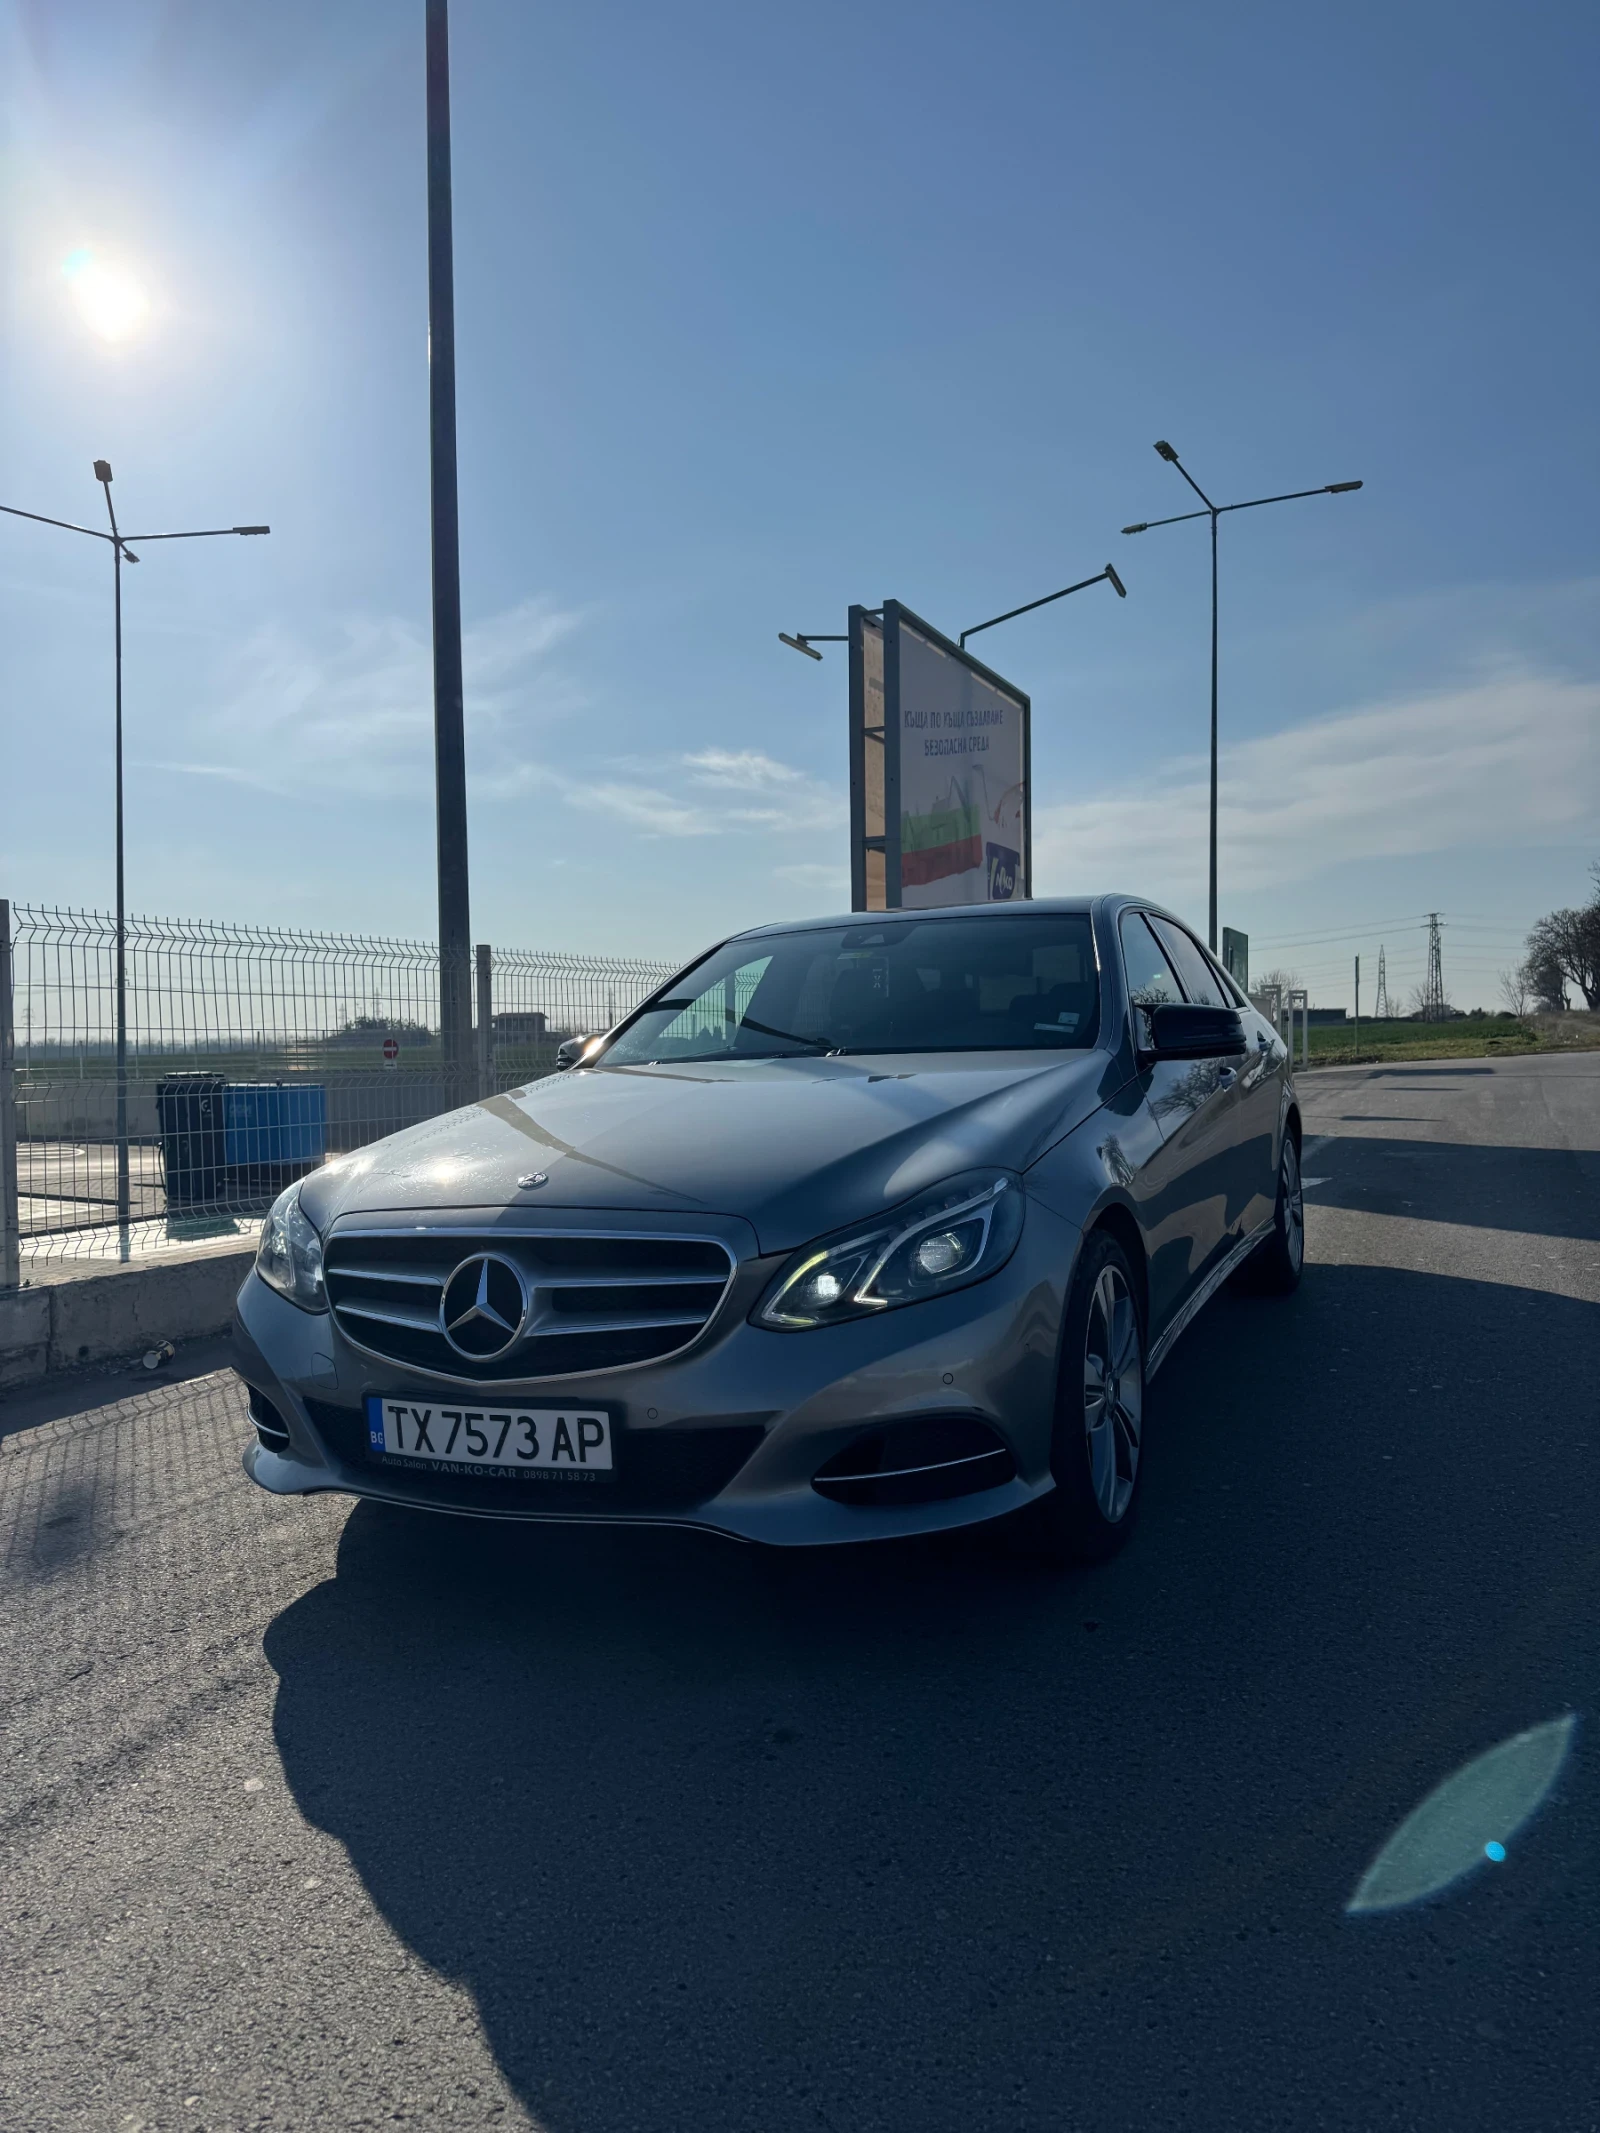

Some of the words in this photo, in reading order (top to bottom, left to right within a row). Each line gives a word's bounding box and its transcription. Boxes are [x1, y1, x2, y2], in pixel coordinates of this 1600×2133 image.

[930, 711, 941, 728] ПО
[924, 738, 967, 756] БЕЗОПАСНА
[968, 736, 990, 752] СРЕДА
[370, 1431, 384, 1444] BG
[381, 1456, 402, 1467] Auto
[403, 1458, 427, 1470] Salon
[431, 1461, 517, 1478] VAN-KO-CAR
